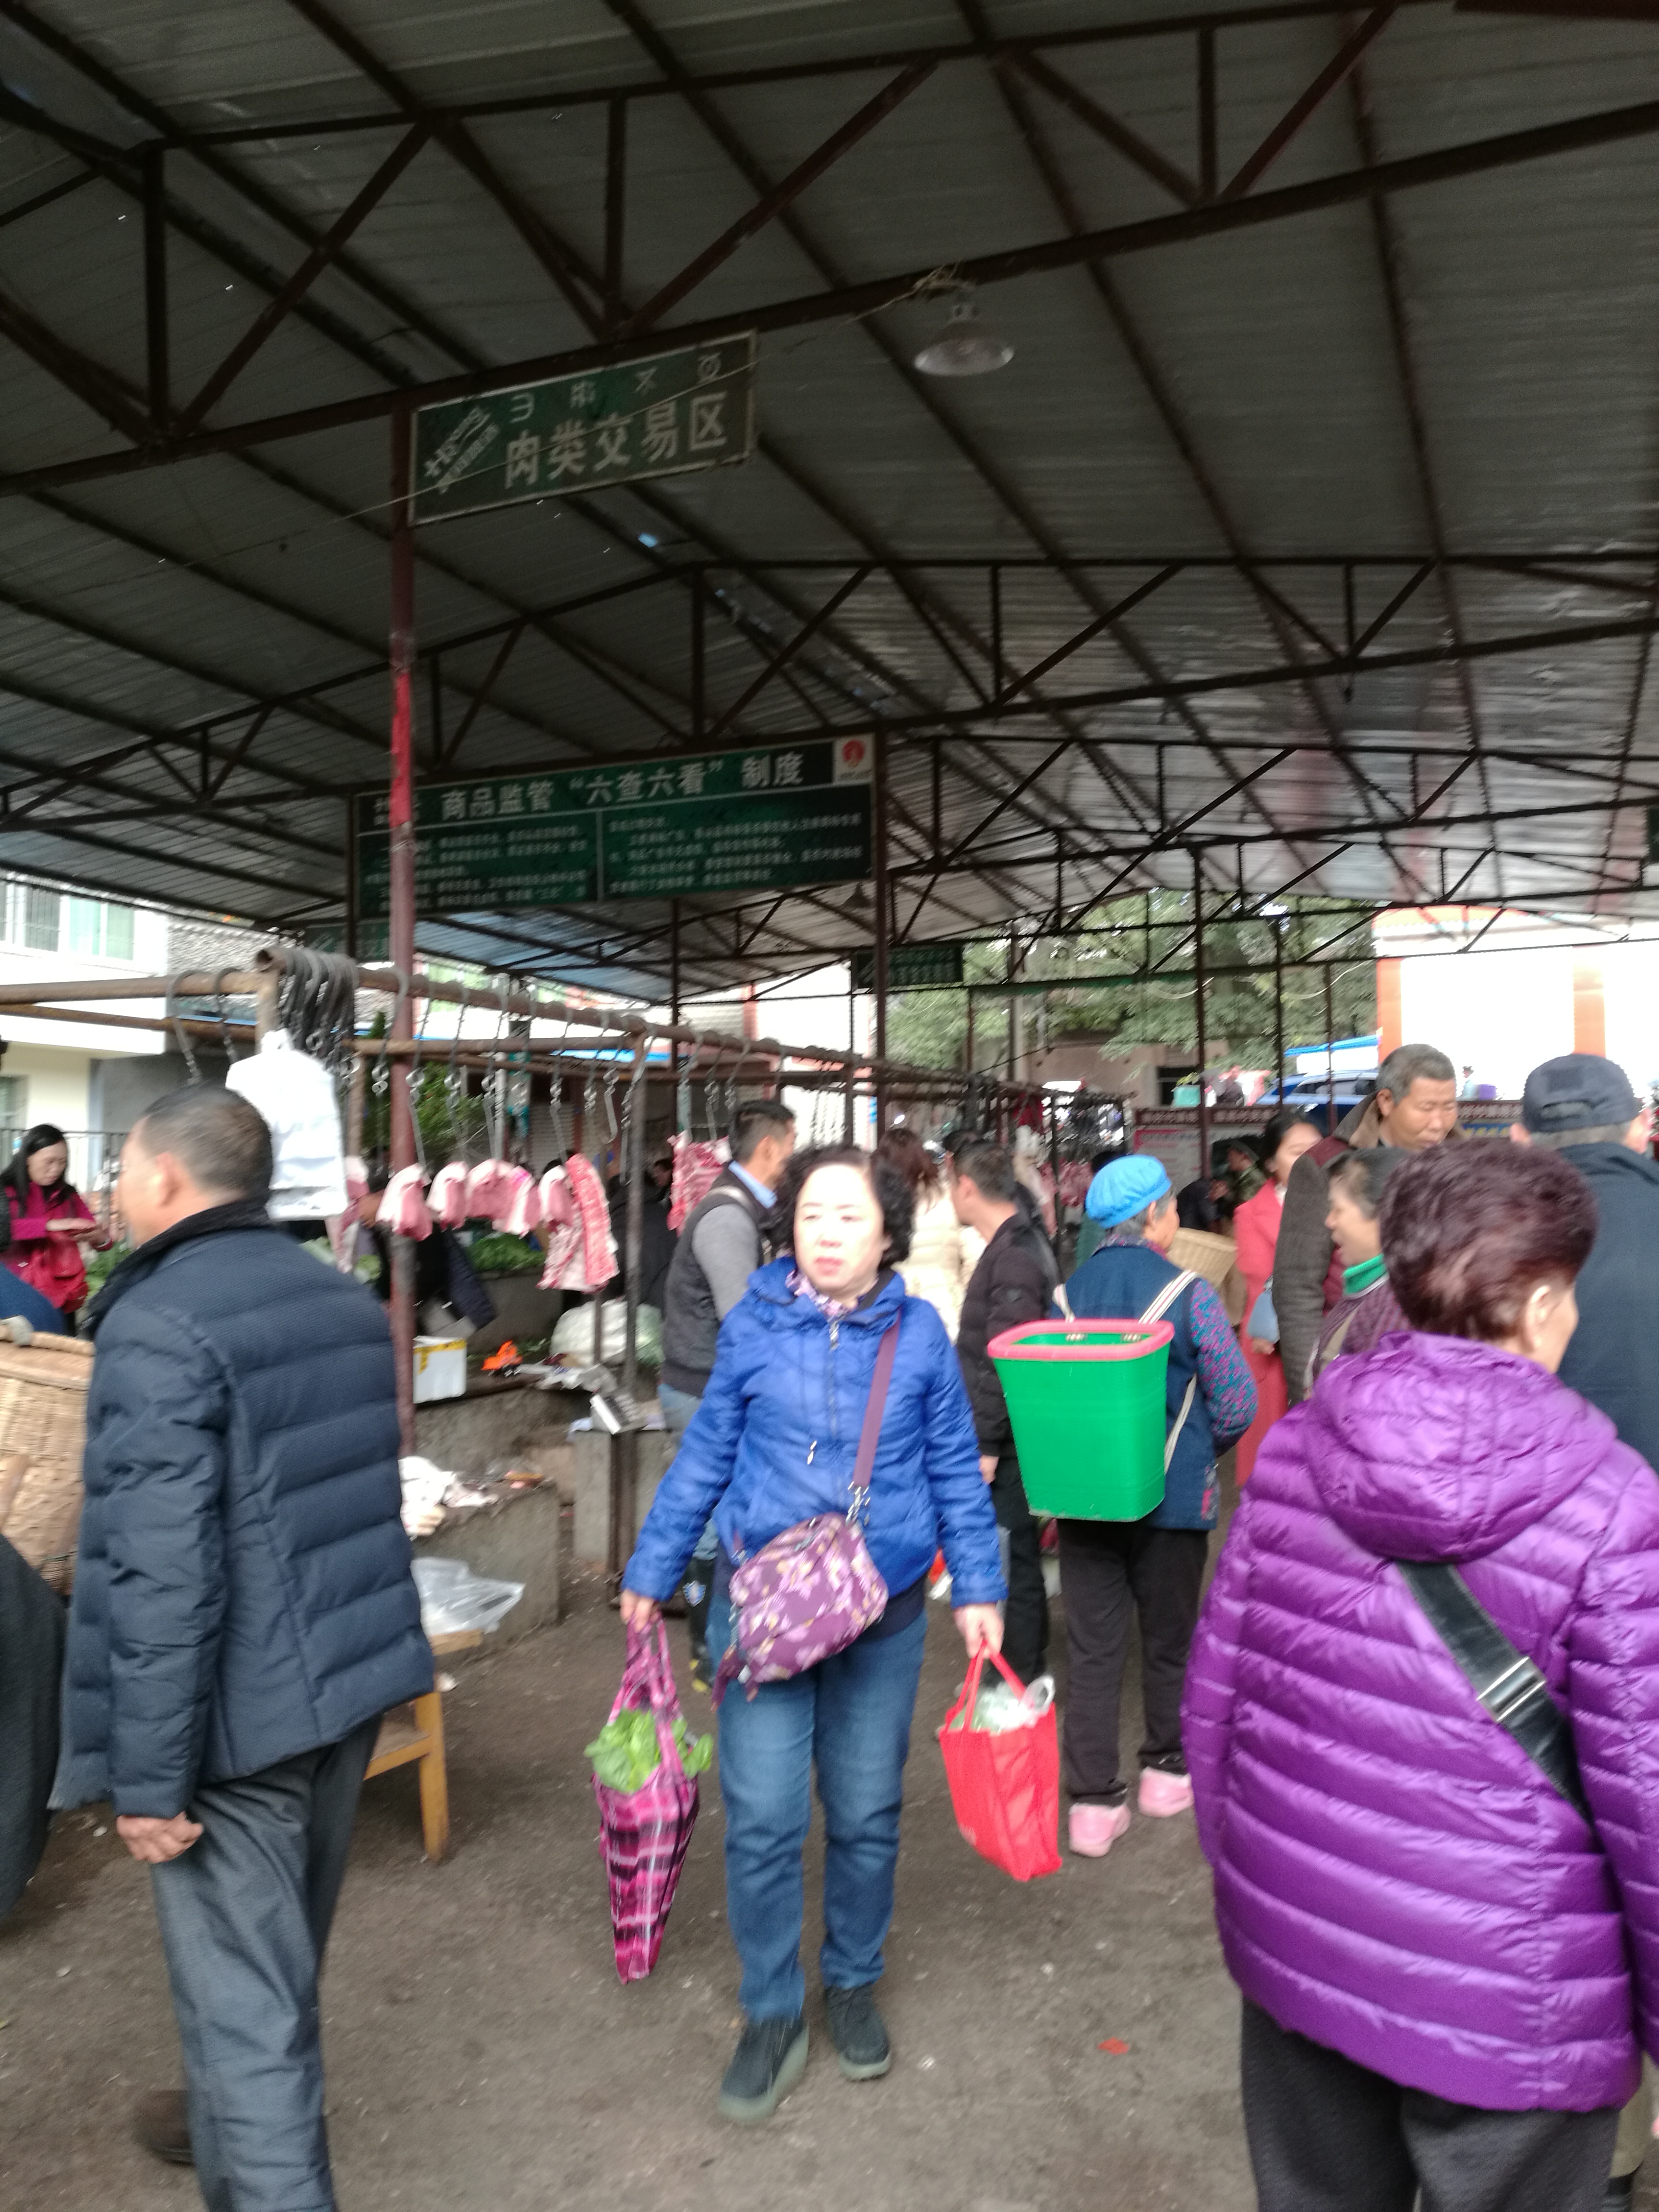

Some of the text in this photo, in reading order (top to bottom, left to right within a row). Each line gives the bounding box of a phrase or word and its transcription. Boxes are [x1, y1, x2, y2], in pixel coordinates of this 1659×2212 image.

[505, 392, 727, 489] 肉类交易区
[442, 780, 554, 820] 商品监管
[741, 751, 805, 789] 制度
